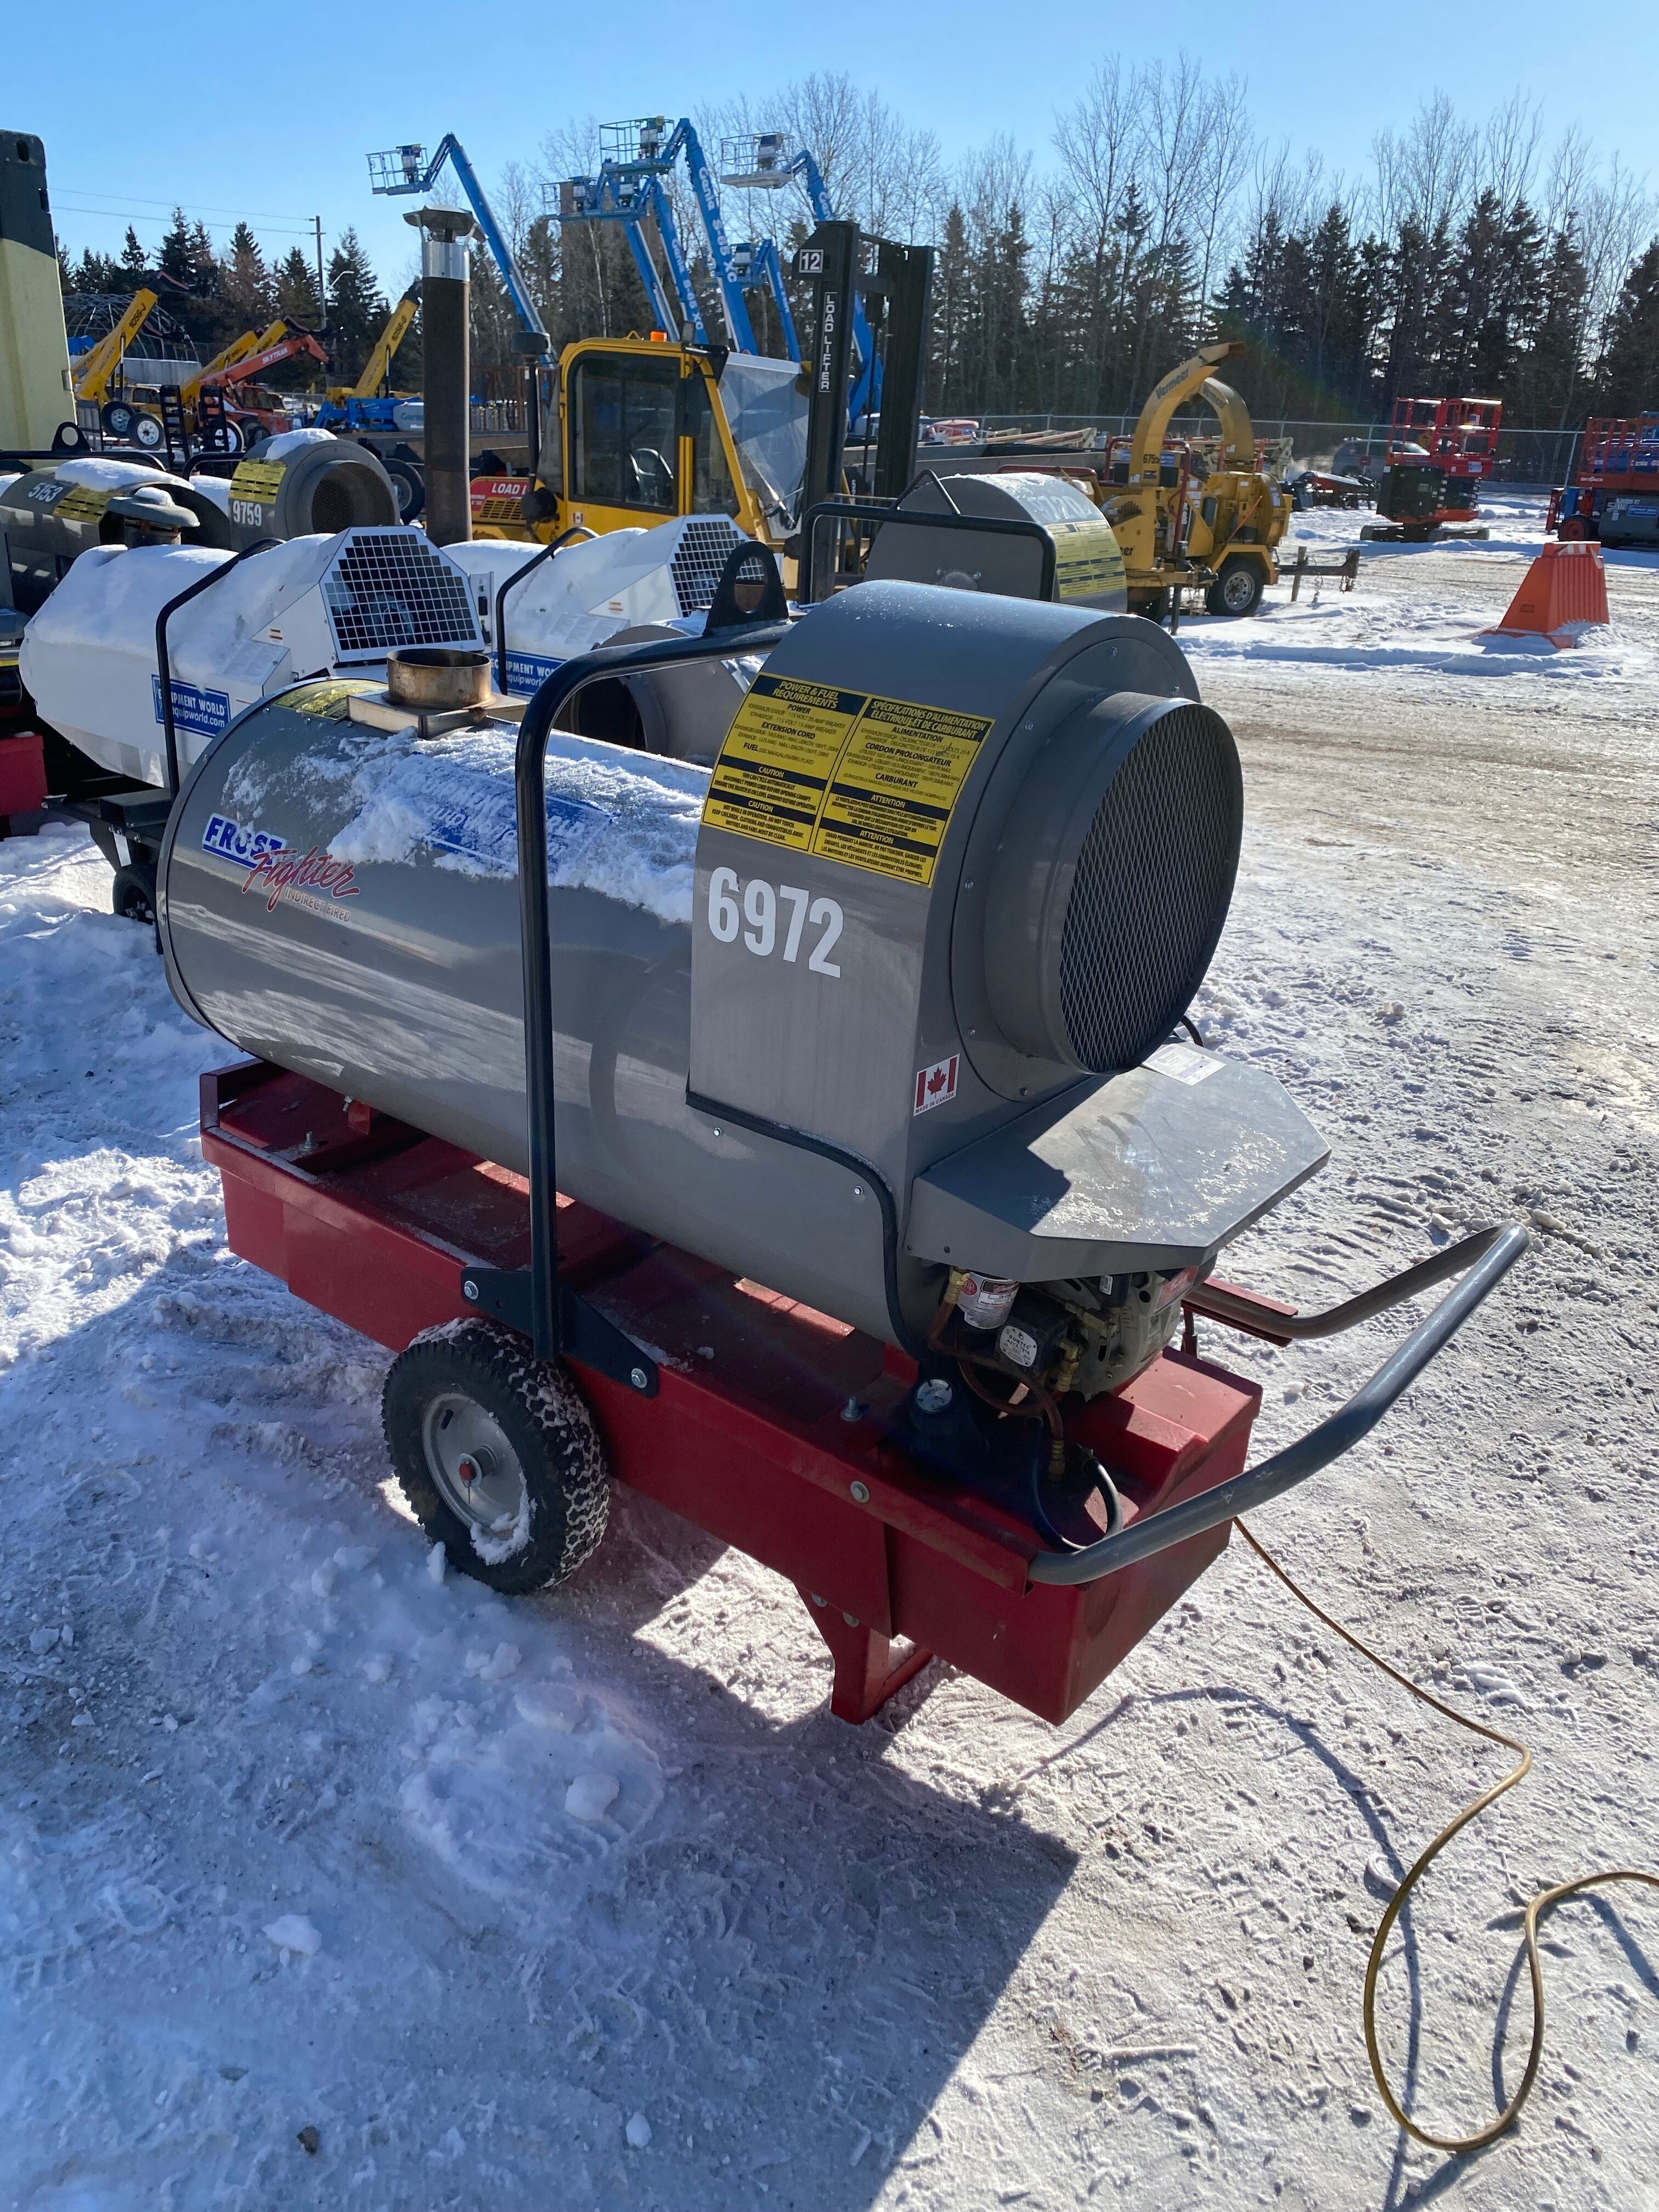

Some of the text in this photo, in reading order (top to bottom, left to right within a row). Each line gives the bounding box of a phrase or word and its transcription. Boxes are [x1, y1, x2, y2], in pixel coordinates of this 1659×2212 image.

[698, 166, 737, 283] Genie S-65 XC
[802, 252, 820, 270] 12
[692, 312, 703, 329] XC
[821, 295, 835, 390] LOAD LIFTER
[29, 482, 63, 503] 5153
[492, 483, 520, 494] LOAD
[233, 500, 262, 527] 9759
[772, 688, 838, 709] REQUIREMENTS
[778, 681, 840, 700] POWER & FUEL
[787, 704, 811, 714] POWER
[761, 721, 797, 735] EXTENSION
[796, 729, 816, 739] CORD
[912, 718, 923, 727] ET
[921, 719, 933, 730] DE
[930, 721, 978, 739] CARBURANT
[925, 710, 987, 731] D'ALIMENTATION
[891, 726, 943, 743] ALIMENTATION
[743, 742, 760, 752] FUEL
[865, 742, 894, 754] CORDON
[895, 748, 952, 767] PROLONGATEUR
[758, 766, 785, 778] CAUTION
[874, 772, 918, 788] CARBURANT
[747, 800, 774, 812] CAUTION
[870, 794, 906, 808] ATTENTION
[205, 817, 283, 865] FROST
[859, 830, 894, 844] ATTENTION
[241, 845, 360, 912] Fighter
[285, 887, 352, 923] INDIRECT FIRED
[708, 867, 844, 978] 6972
[915, 1104, 929, 1114] MADE
[935, 1092, 953, 1104] CANADA
[1009, 1335, 1030, 1350] SURTEC
